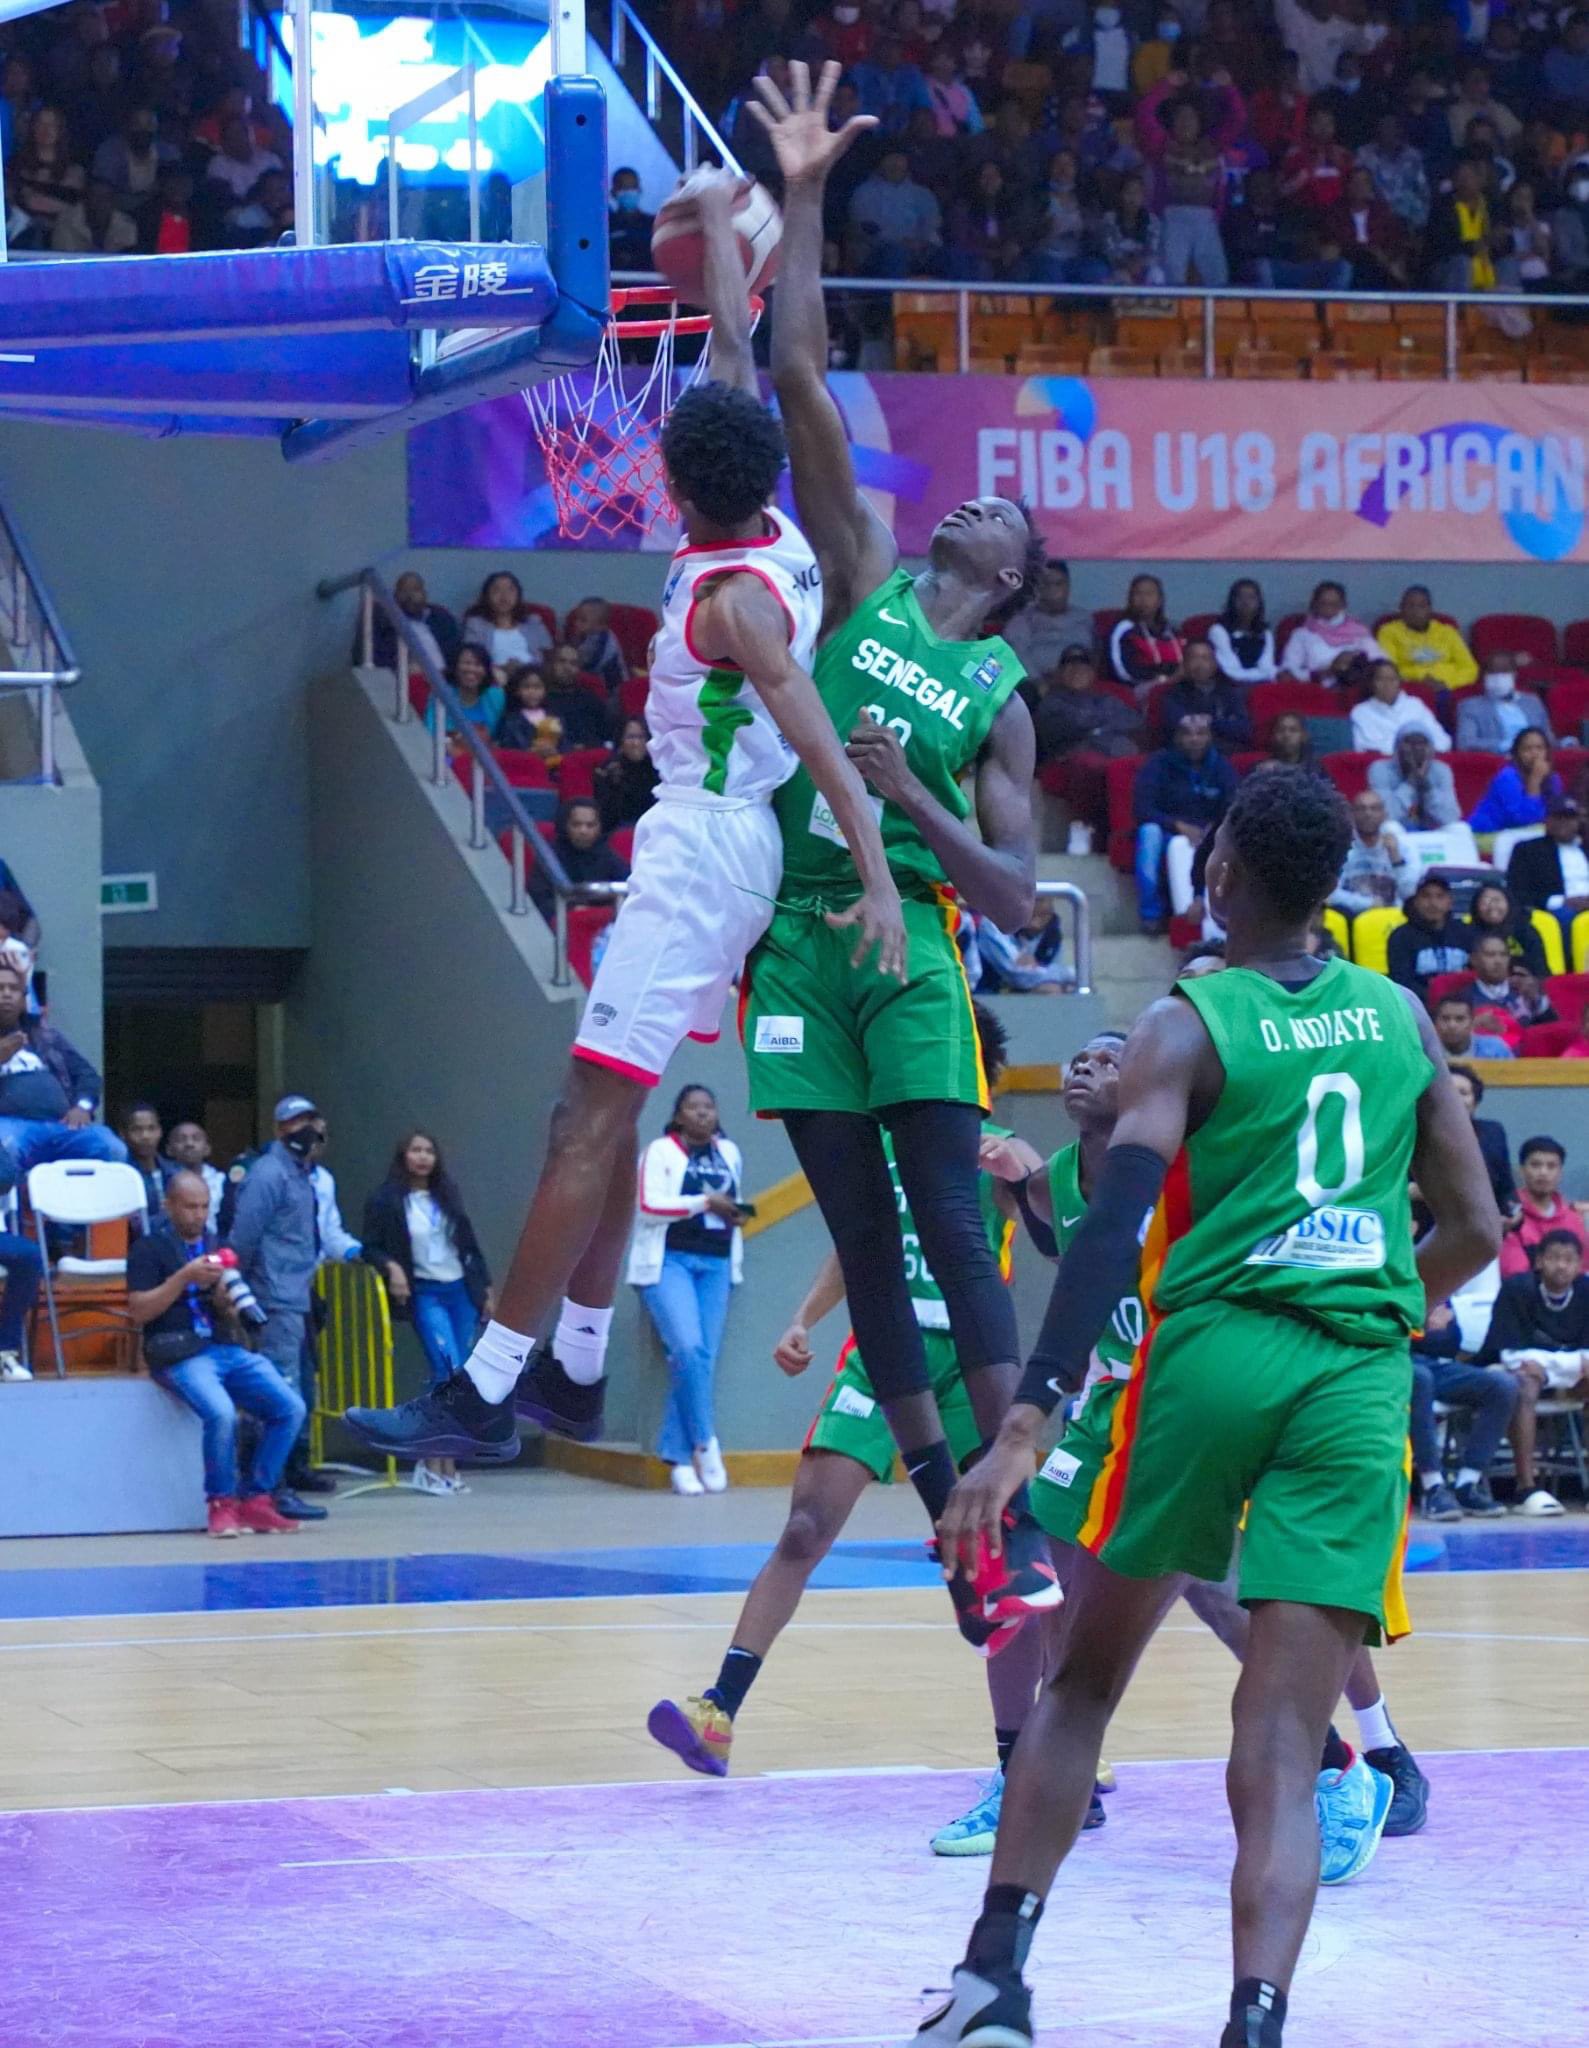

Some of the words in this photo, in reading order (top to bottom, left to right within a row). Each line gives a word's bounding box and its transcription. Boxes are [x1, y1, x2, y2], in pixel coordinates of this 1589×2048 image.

[412, 261, 512, 300] 金陵
[977, 429, 1133, 509] FIBA
[1153, 431, 1276, 511] U18
[1299, 431, 1587, 513] AFRICAN
[851, 638, 970, 731] SENEGAL
[1288, 1007, 1384, 1050] NDIAYE
[1295, 1072, 1365, 1207] 0
[1296, 1210, 1375, 1245] BSIC
